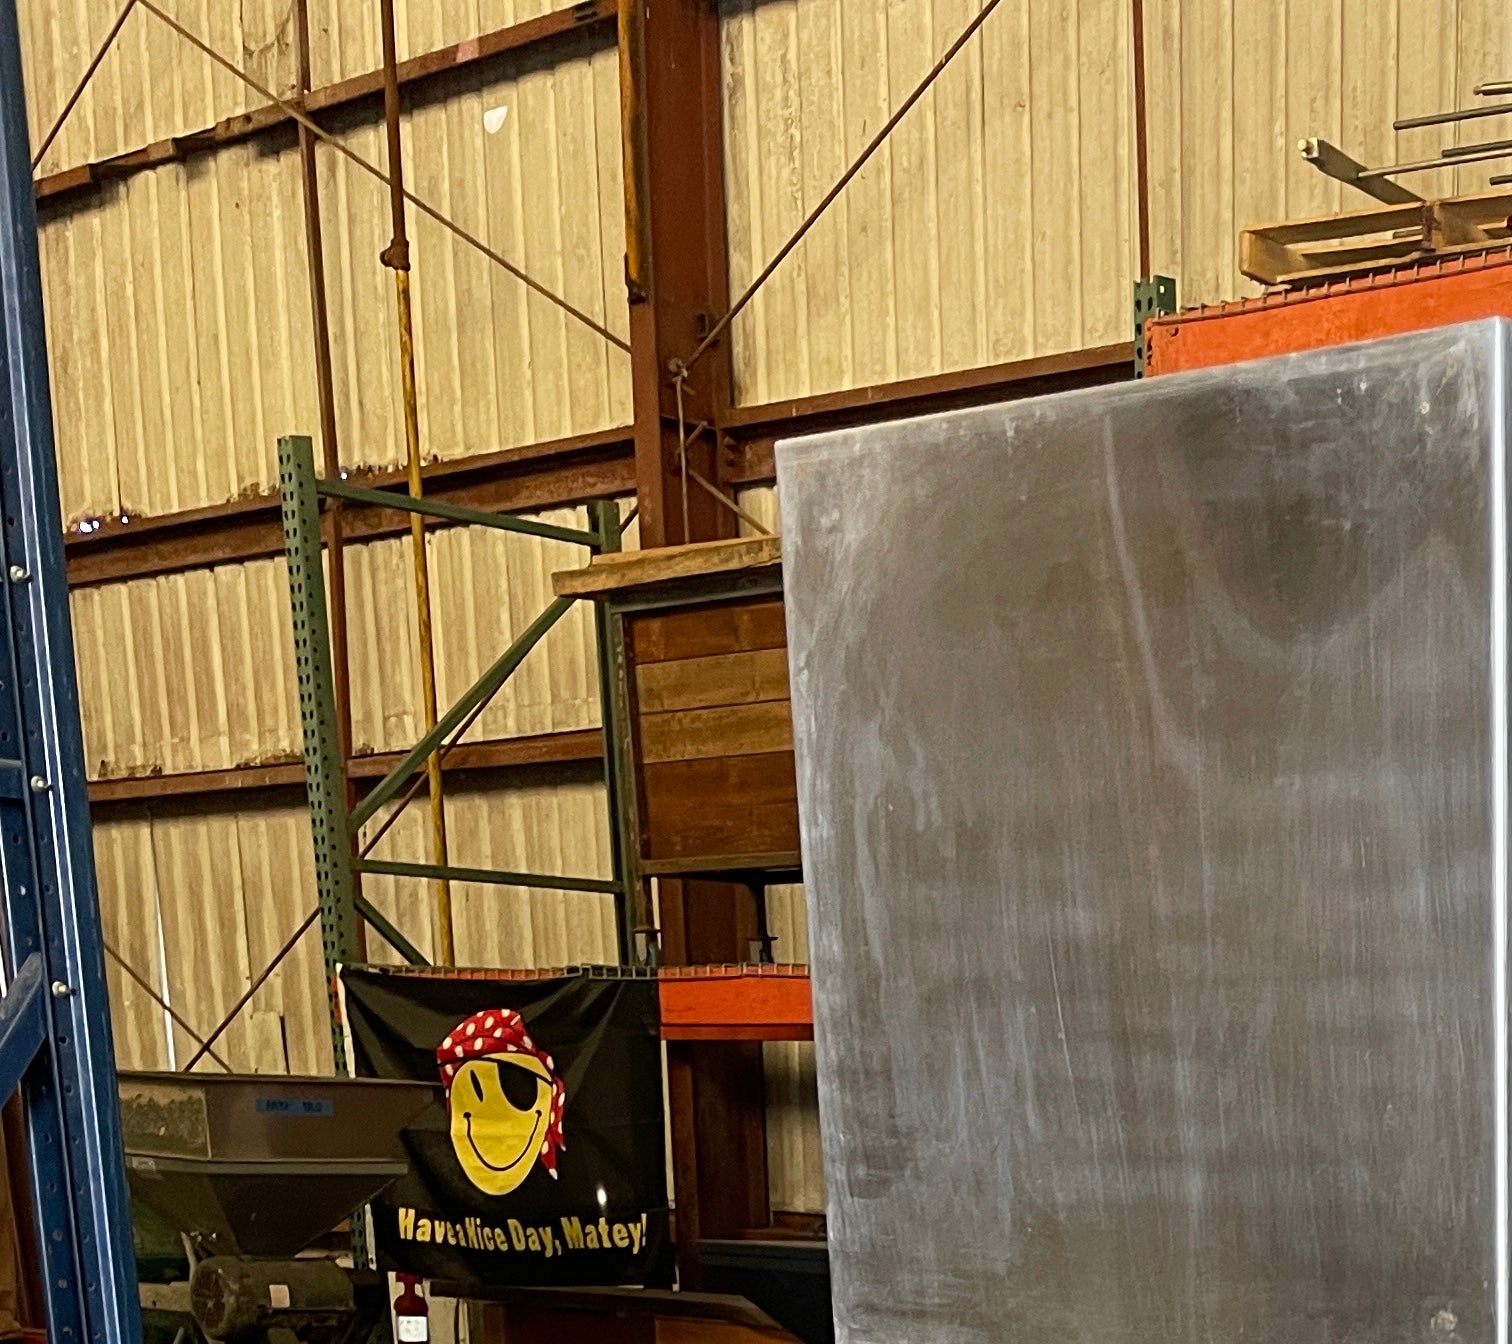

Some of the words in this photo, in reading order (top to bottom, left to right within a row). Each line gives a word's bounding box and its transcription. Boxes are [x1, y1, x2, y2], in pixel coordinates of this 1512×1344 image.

[398, 1207, 457, 1246] Have
[456, 1223, 467, 1247] a
[465, 1217, 508, 1251] Nice
[507, 1218, 562, 1258] Day,
[560, 1213, 647, 1255] Matey!
